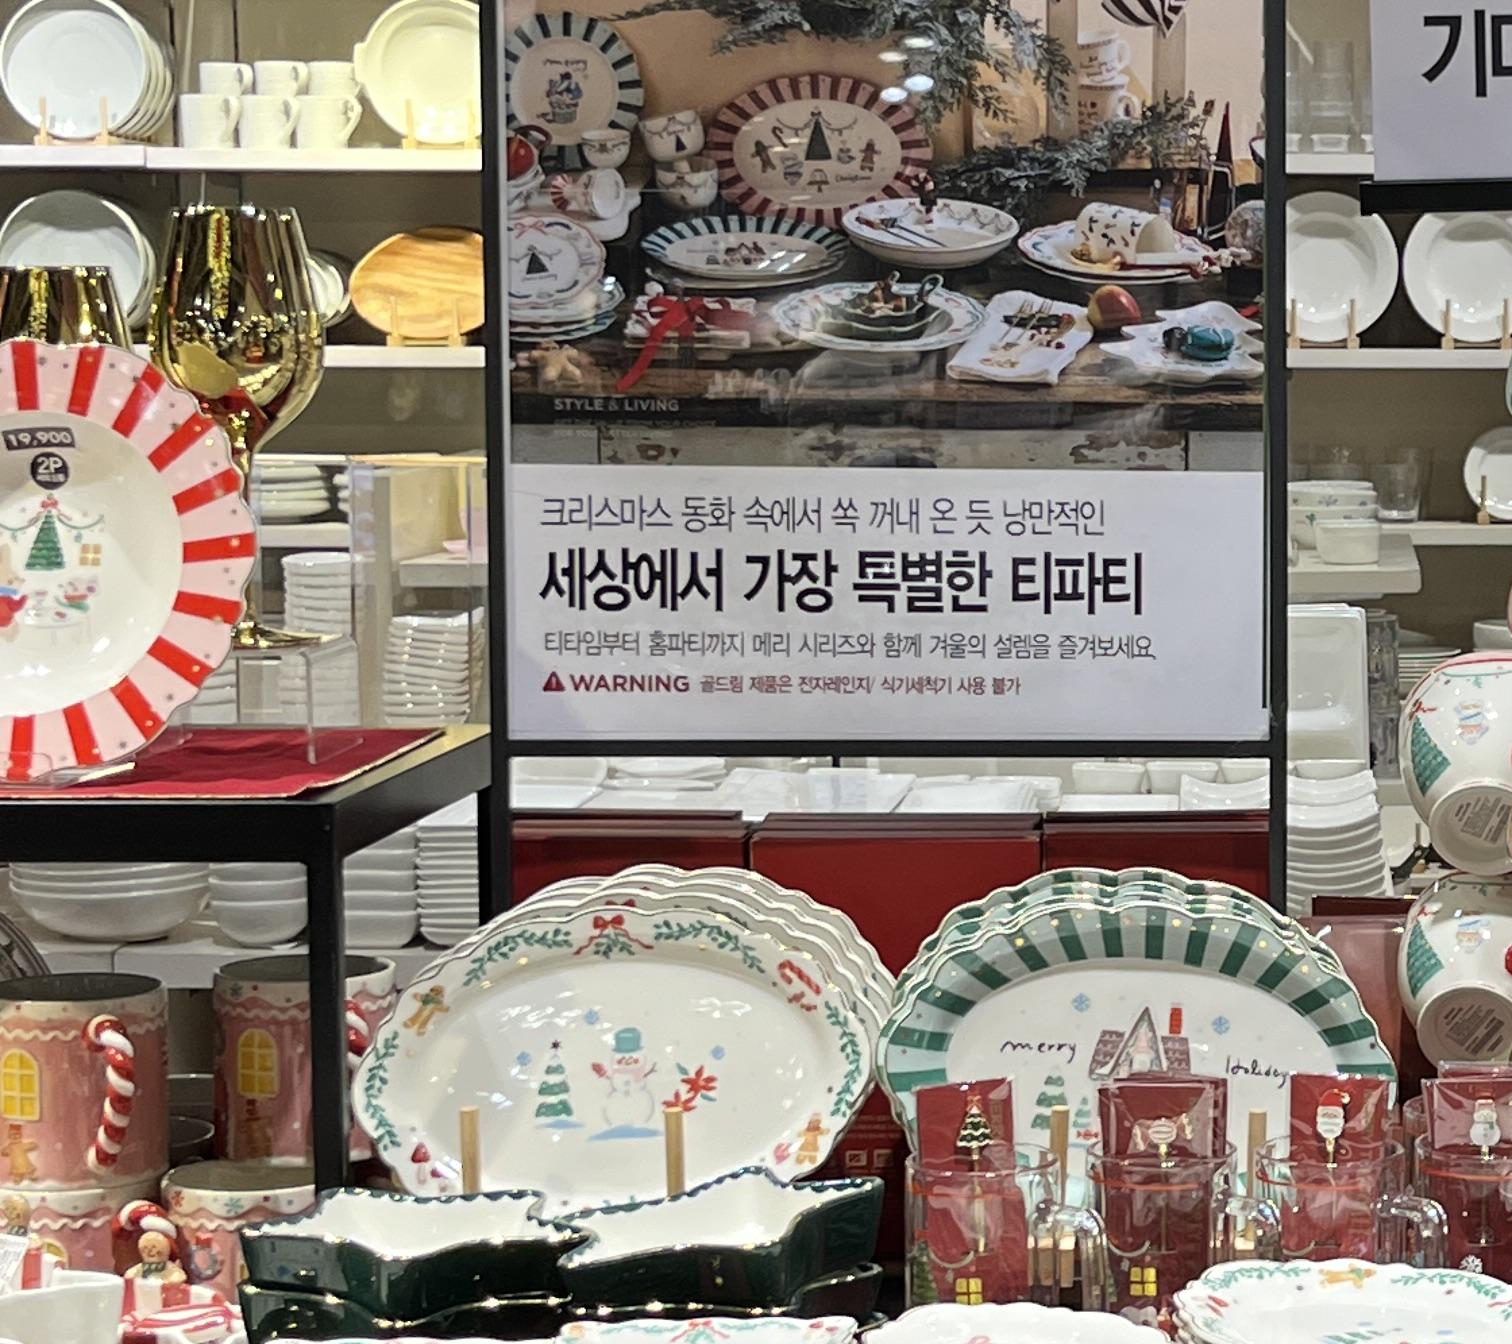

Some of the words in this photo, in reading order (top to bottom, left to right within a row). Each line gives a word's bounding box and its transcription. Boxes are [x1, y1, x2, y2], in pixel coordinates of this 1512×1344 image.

[554, 398, 604, 411] STYLE
[624, 399, 680, 412] LIVING
[8, 431, 73, 447] 19,900
[37, 457, 63, 473] 2P
[540, 494, 673, 531] 크리스마스
[681, 496, 735, 533] 동화
[743, 496, 822, 534] 속에서
[831, 497, 860, 534] 쏙
[869, 497, 920, 535] 꺼내
[929, 497, 958, 535] 온
[965, 499, 994, 536] 듯
[1002, 499, 1105, 537] 낭만적인
[539, 547, 723, 613] 세상에서
[743, 548, 838, 613] 가장
[853, 549, 993, 614] 특별한
[1011, 551, 1142, 616] 티파티
[544, 630, 640, 656] 티타임부터
[648, 630, 745, 657] 홈파티까지
[752, 631, 790, 657] 메리
[798, 631, 876, 658] 시리즈와
[883, 632, 922, 658] 함께
[929, 632, 986, 658] 겨울의
[993, 633, 1051, 659] 설렘을
[569, 673, 690, 693] WARNING
[750, 674, 793, 694] 제품은
[881, 675, 952, 695] 식기세척기
[957, 676, 986, 695] 사용
[1000, 1039, 1077, 1064] merry
